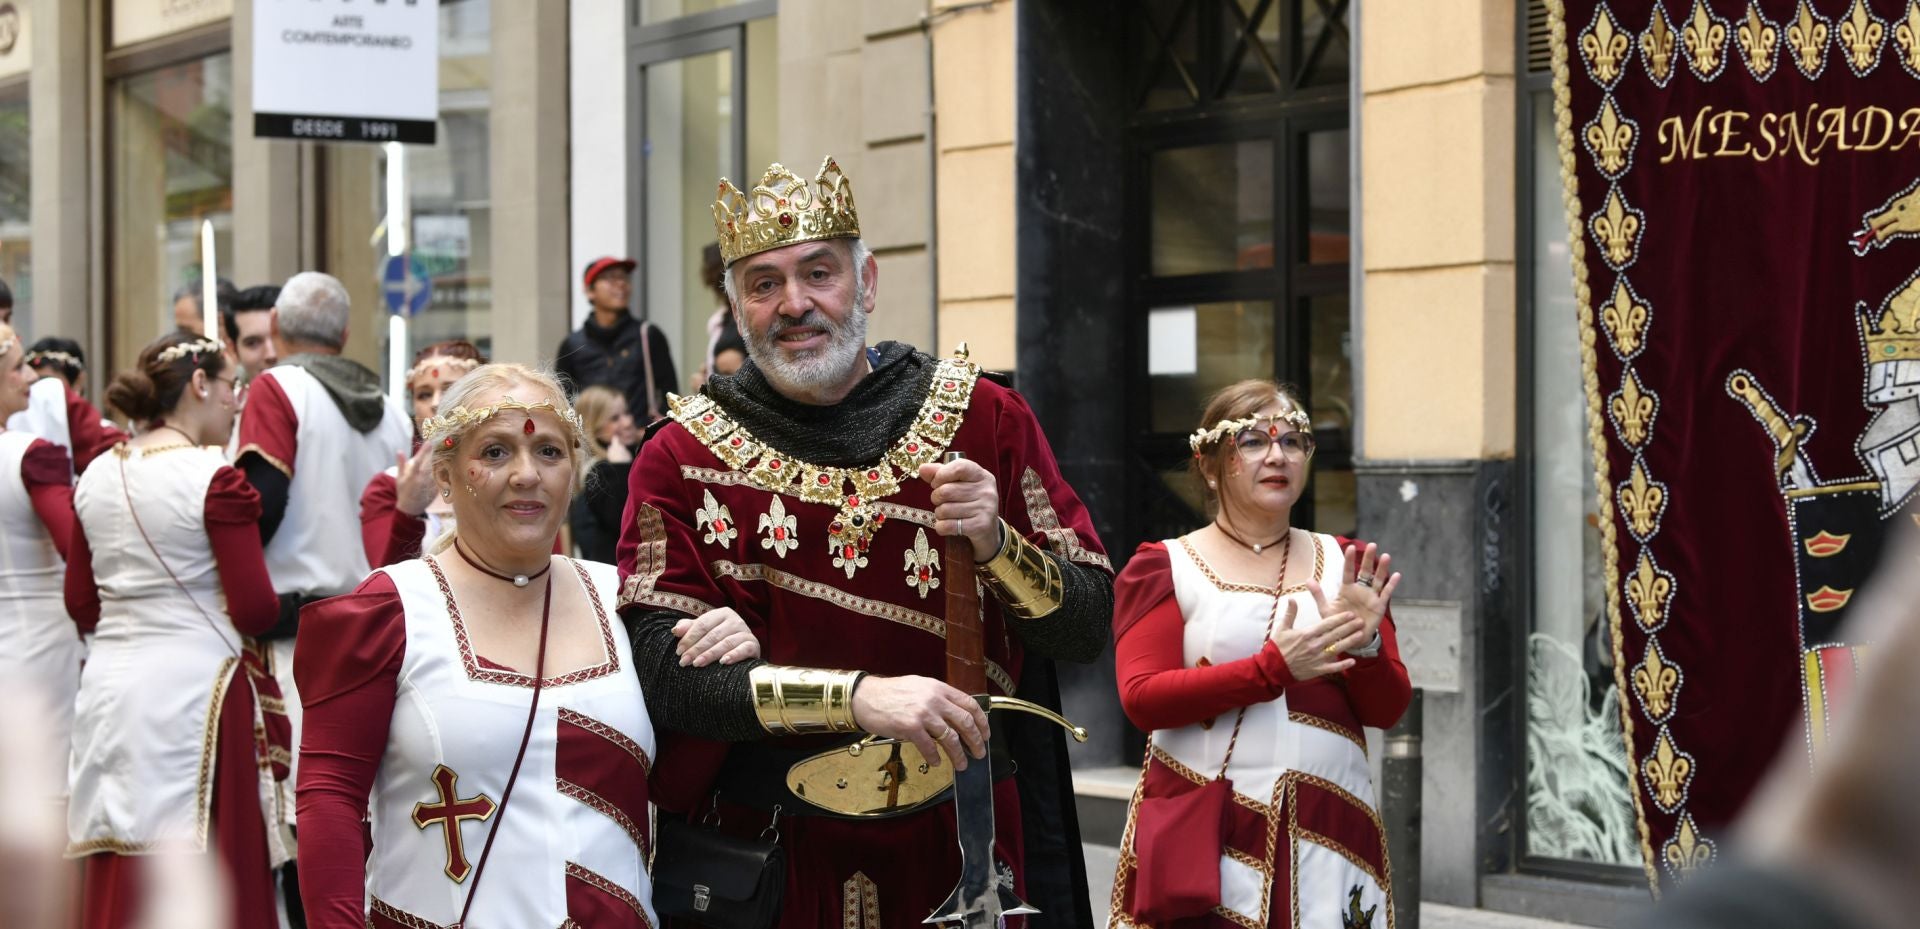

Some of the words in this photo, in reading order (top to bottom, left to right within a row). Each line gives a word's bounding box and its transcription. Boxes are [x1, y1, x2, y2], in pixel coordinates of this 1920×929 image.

[332, 15, 363, 28] ARTE
[292, 119, 345, 138] DESDE
[360, 122, 398, 139] 1991
